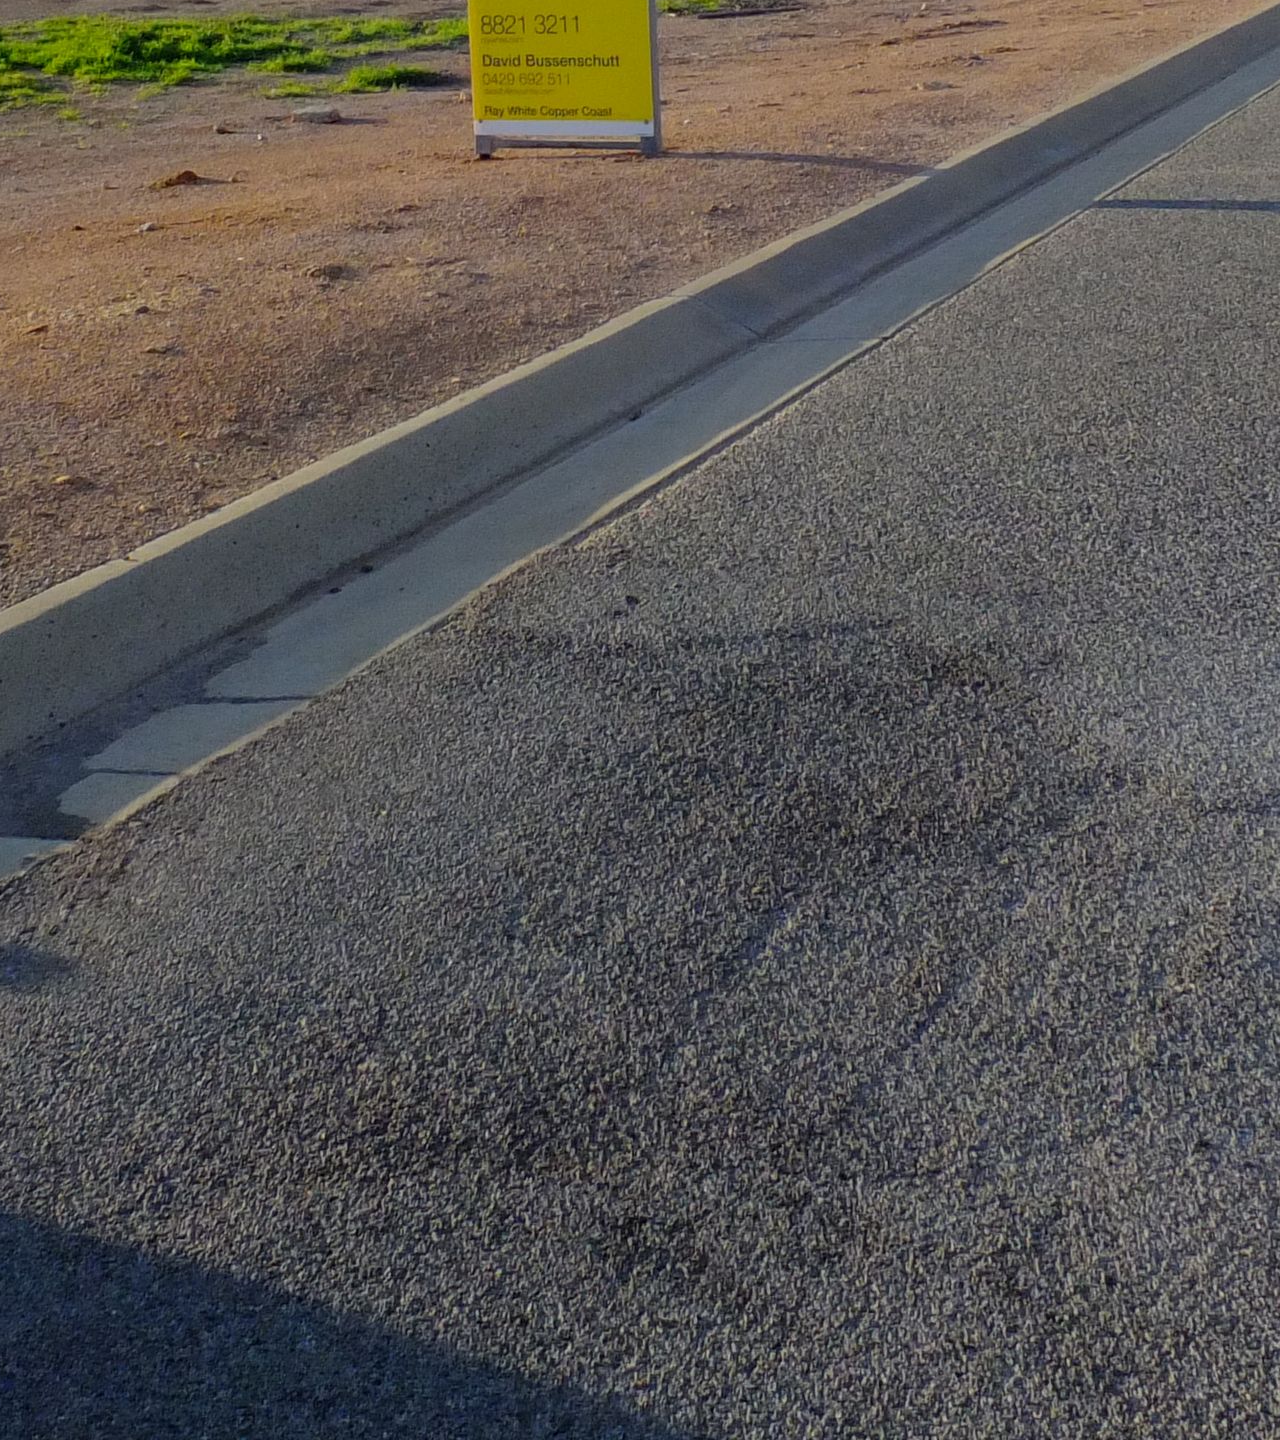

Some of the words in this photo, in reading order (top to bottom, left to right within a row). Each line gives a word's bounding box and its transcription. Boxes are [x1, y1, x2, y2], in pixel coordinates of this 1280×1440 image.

[480, 15, 526, 35] 8821
[534, 14, 580, 35] 3211
[482, 54, 521, 67] David
[525, 54, 620, 68] Bussenschutt
[484, 105, 504, 118] Ray
[507, 106, 537, 116] White
[539, 105, 579, 118] Copper
[582, 105, 613, 117] Coast
